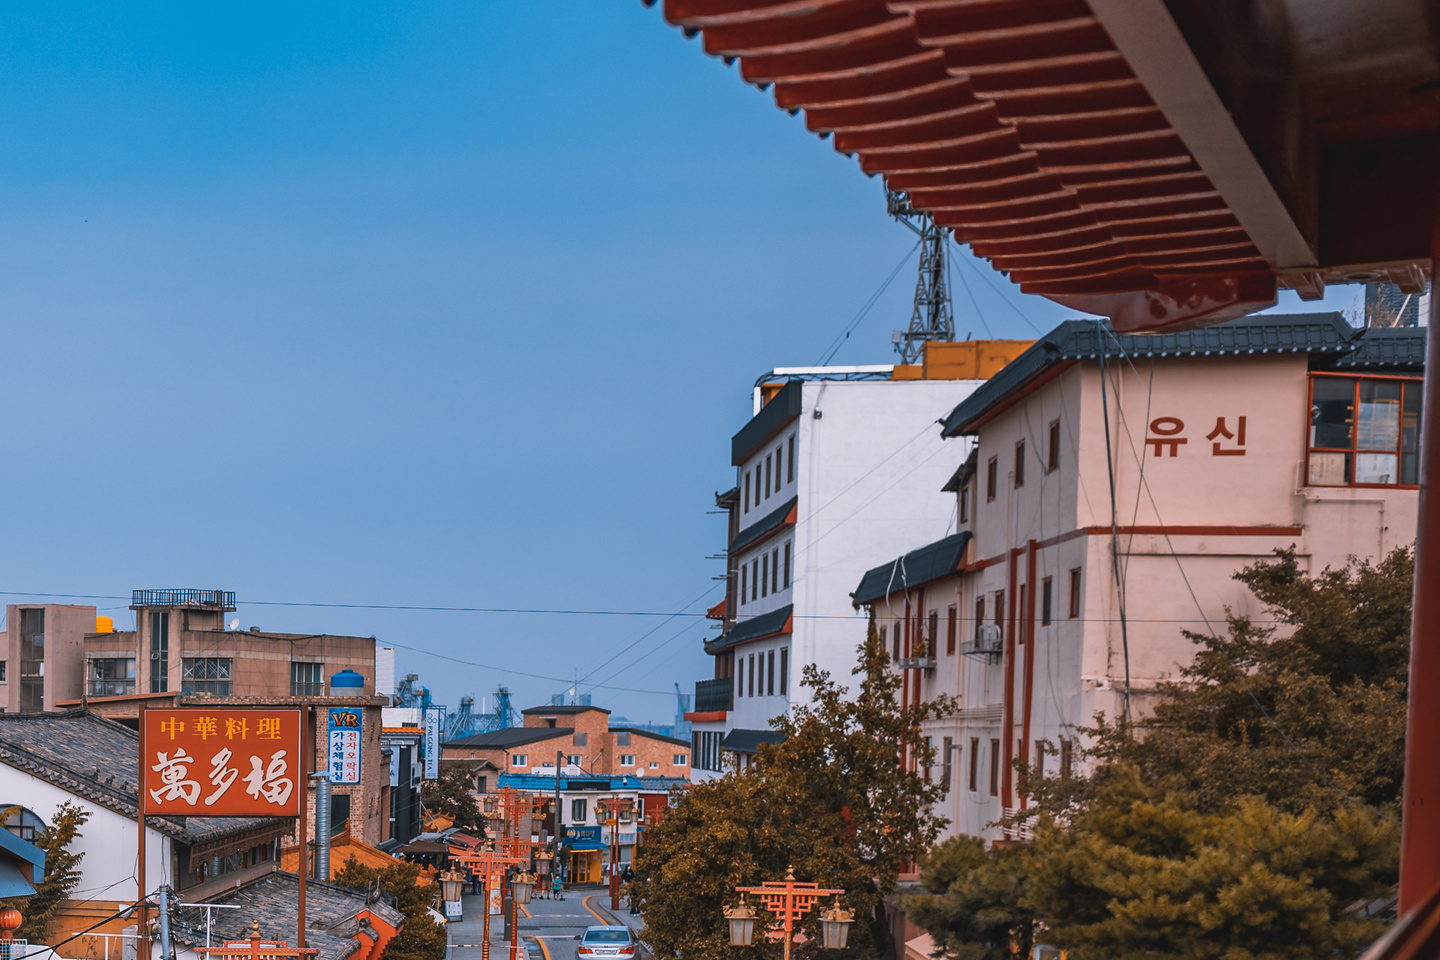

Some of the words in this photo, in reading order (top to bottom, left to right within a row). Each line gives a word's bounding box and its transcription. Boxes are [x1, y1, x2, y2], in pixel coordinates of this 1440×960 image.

[1145, 415, 1247, 458] 유신
[161, 716, 282, 741] 中華料理
[331, 711, 360, 728] VR
[150, 747, 294, 806] 萬多福
[333, 732, 345, 780] 가상체험실
[346, 732, 357, 780] 전자오락실
